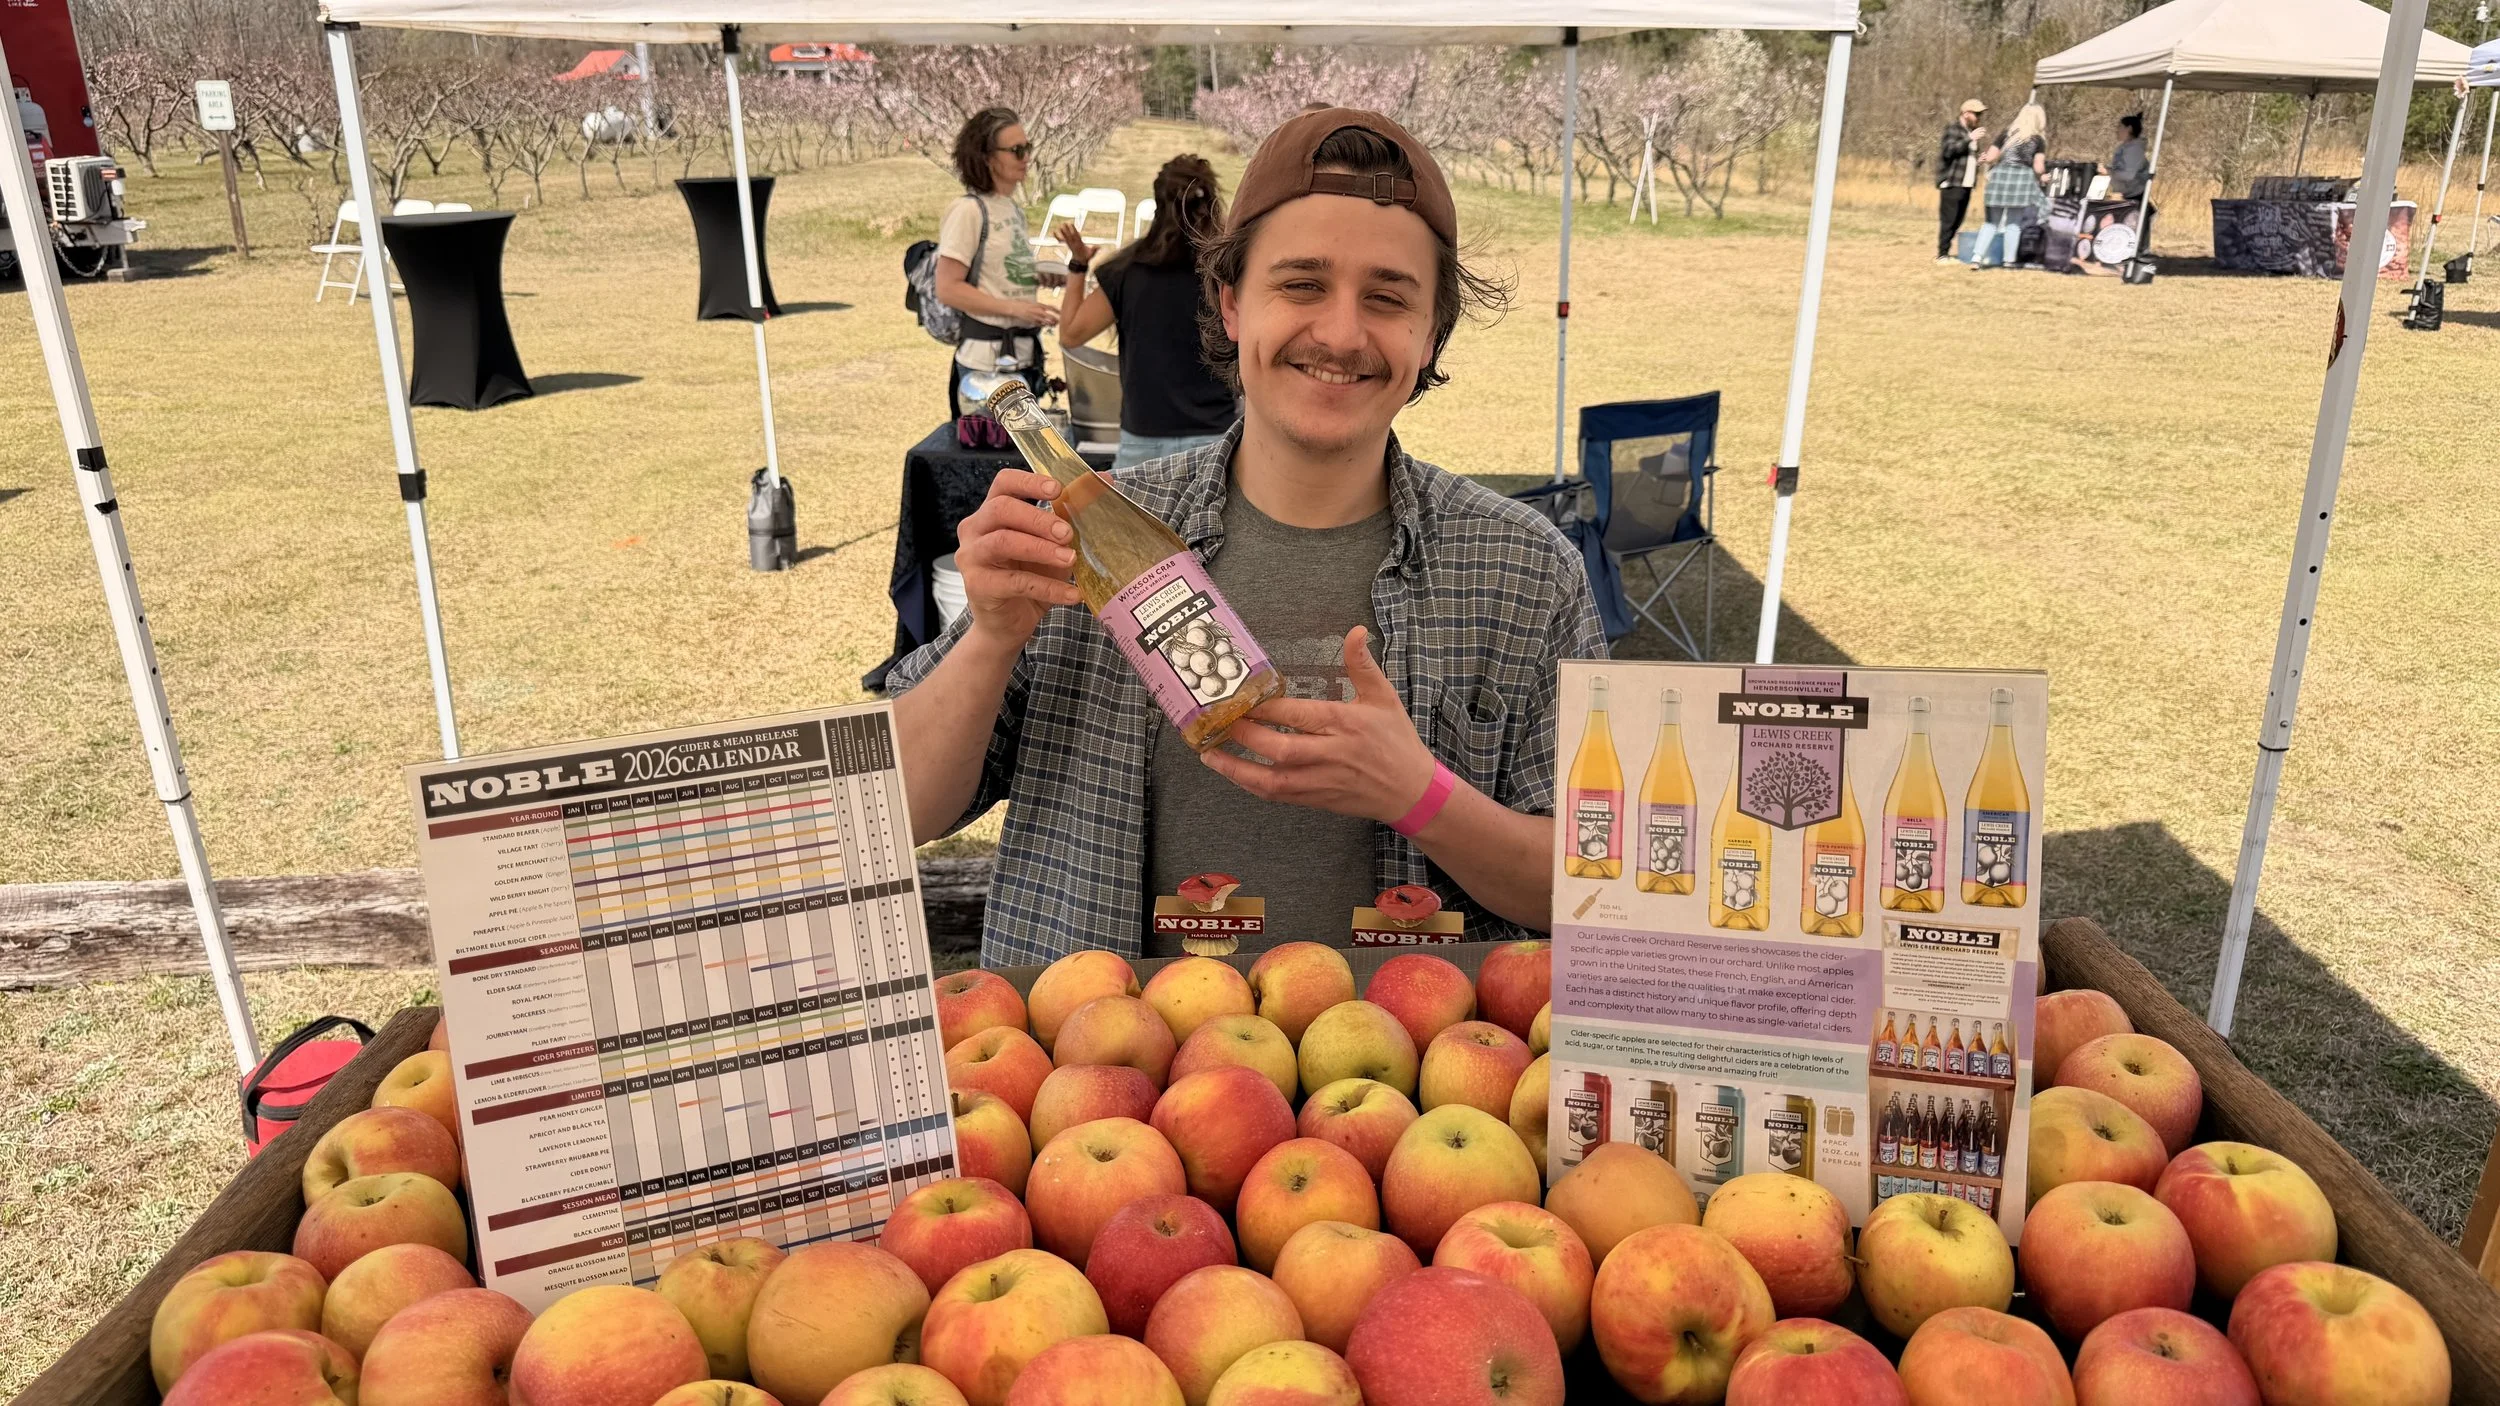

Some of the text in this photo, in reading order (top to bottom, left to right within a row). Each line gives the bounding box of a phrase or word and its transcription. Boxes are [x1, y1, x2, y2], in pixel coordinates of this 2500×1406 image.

[1118, 561, 1176, 602] WICKSON CRAB
[1132, 573, 1169, 600] SINGLE VARIETAL
[1139, 582, 1182, 615] LEWIS CREEK
[1143, 589, 1187, 621] ORCHARD RESERVE
[1144, 598, 1208, 646] NOBLE
[1754, 685, 1821, 693] HENDERSONVILLE,
[1733, 702, 1854, 719] NOBLE
[678, 728, 798, 753] CIDER & MEAD RELEASE
[1753, 728, 1832, 741] LEWIS CREEK
[680, 739, 802, 774] CALENDAR
[427, 745, 682, 807] NOBLE 2026
[510, 807, 559, 824] YEAR-ROUND
[567, 806, 580, 814] JAN
[611, 799, 628, 807] MAR
[635, 796, 649, 804] APR
[657, 792, 673, 800] MAY
[703, 784, 718, 793] JUL
[725, 782, 739, 790] AUG
[767, 774, 782, 783] OCT
[812, 769, 824, 777] DEC
[1576, 812, 1612, 820] NOBLE
[482, 828, 539, 842] STANDARD BEARER
[1648, 826, 1685, 834] NOBLE
[1894, 841, 1934, 849] NOBLE
[1975, 835, 2016, 843] NOBLE
[1721, 861, 1759, 869] NOBLE
[1814, 867, 1853, 875] NOBLE
[488, 909, 507, 917] APPLE
[1158, 918, 1260, 930] NOBLE
[455, 943, 488, 954] BILTMORE
[489, 940, 506, 948] BLUE
[507, 936, 526, 945] RIDGE
[527, 933, 546, 942] CIDER
[1356, 932, 1460, 944] NOBLE
[1907, 928, 1993, 946] NOBLE
[539, 942, 579, 955] SEASONAL
[1577, 931, 1846, 963] Our Lewis Creek Orchard Reserve series showcases the cider-
[1972, 948, 1998, 956] RESERVE
[1570, 944, 1603, 954] specific
[1604, 947, 1629, 957] apple
[1631, 949, 1666, 959] varieties
[1668, 953, 1697, 963] grown
[1699, 954, 1707, 962] in
[1726, 957, 1763, 968] orchard.
[1766, 961, 1795, 970] Unlike
[1797, 964, 1821, 973] most
[1822, 966, 1853, 977] apples
[1570, 959, 1597, 968] grown
[1609, 960, 1624, 969] the
[1626, 962, 1655, 972] United
[1657, 965, 1686, 975] States,
[1688, 968, 1713, 977] these
[1715, 970, 1748, 981] French,
[1750, 973, 1785, 985] English,
[1788, 977, 1805, 985] and
[1807, 978, 1853, 991] American
[1567, 971, 1601, 981] varieties
[1619, 975, 1655, 986] selected
[1657, 978, 1668, 986] for
[1671, 980, 1686, 988] the
[1688, 982, 1725, 992] qualities
[1727, 986, 1745, 996] that
[1748, 987, 1773, 997] make
[1775, 989, 1828, 1003] exceptional
[1830, 995, 1855, 1005] cider.
[511, 996, 532, 1005] ROYAL
[532, 991, 553, 1003] PEACH
[1566, 984, 1586, 993] Each
[1588, 986, 1603, 995] has
[1612, 988, 1644, 998] distinct
[1646, 991, 1676, 1003] history
[1678, 994, 1695, 1003] and
[1697, 996, 1729, 1008] unique
[1731, 999, 1754, 1009] flavor
[1757, 1002, 1788, 1014] profile,
[1790, 1005, 1826, 1017] offering
[1828, 1009, 1856, 1020] depth
[1569, 998, 1585, 1006] and
[1586, 1000, 1634, 1013] complexity
[1636, 1004, 1654, 1013] that
[1656, 1006, 1679, 1015] allow
[1680, 1010, 1706, 1020] many
[1719, 1013, 1744, 1022] shine
[1757, 1016, 1821, 1030] single-varietal
[1822, 1022, 1851, 1033] ciders.
[532, 1044, 594, 1062] CIDER SPRITZERS
[570, 1088, 601, 1101] LIMITED
[1568, 1100, 1600, 1108] NOBLE
[539, 1104, 603, 1122] PEAR HONEY GINGER
[1633, 1109, 1667, 1118] NOBLE
[1699, 1115, 1735, 1124] NOBLE
[1768, 1121, 1804, 1130] NOBLE
[538, 1133, 607, 1153] LAVENDER LEMONADE
[562, 1192, 617, 1210] SESSION MEAD
[601, 1234, 624, 1249] MEAD
